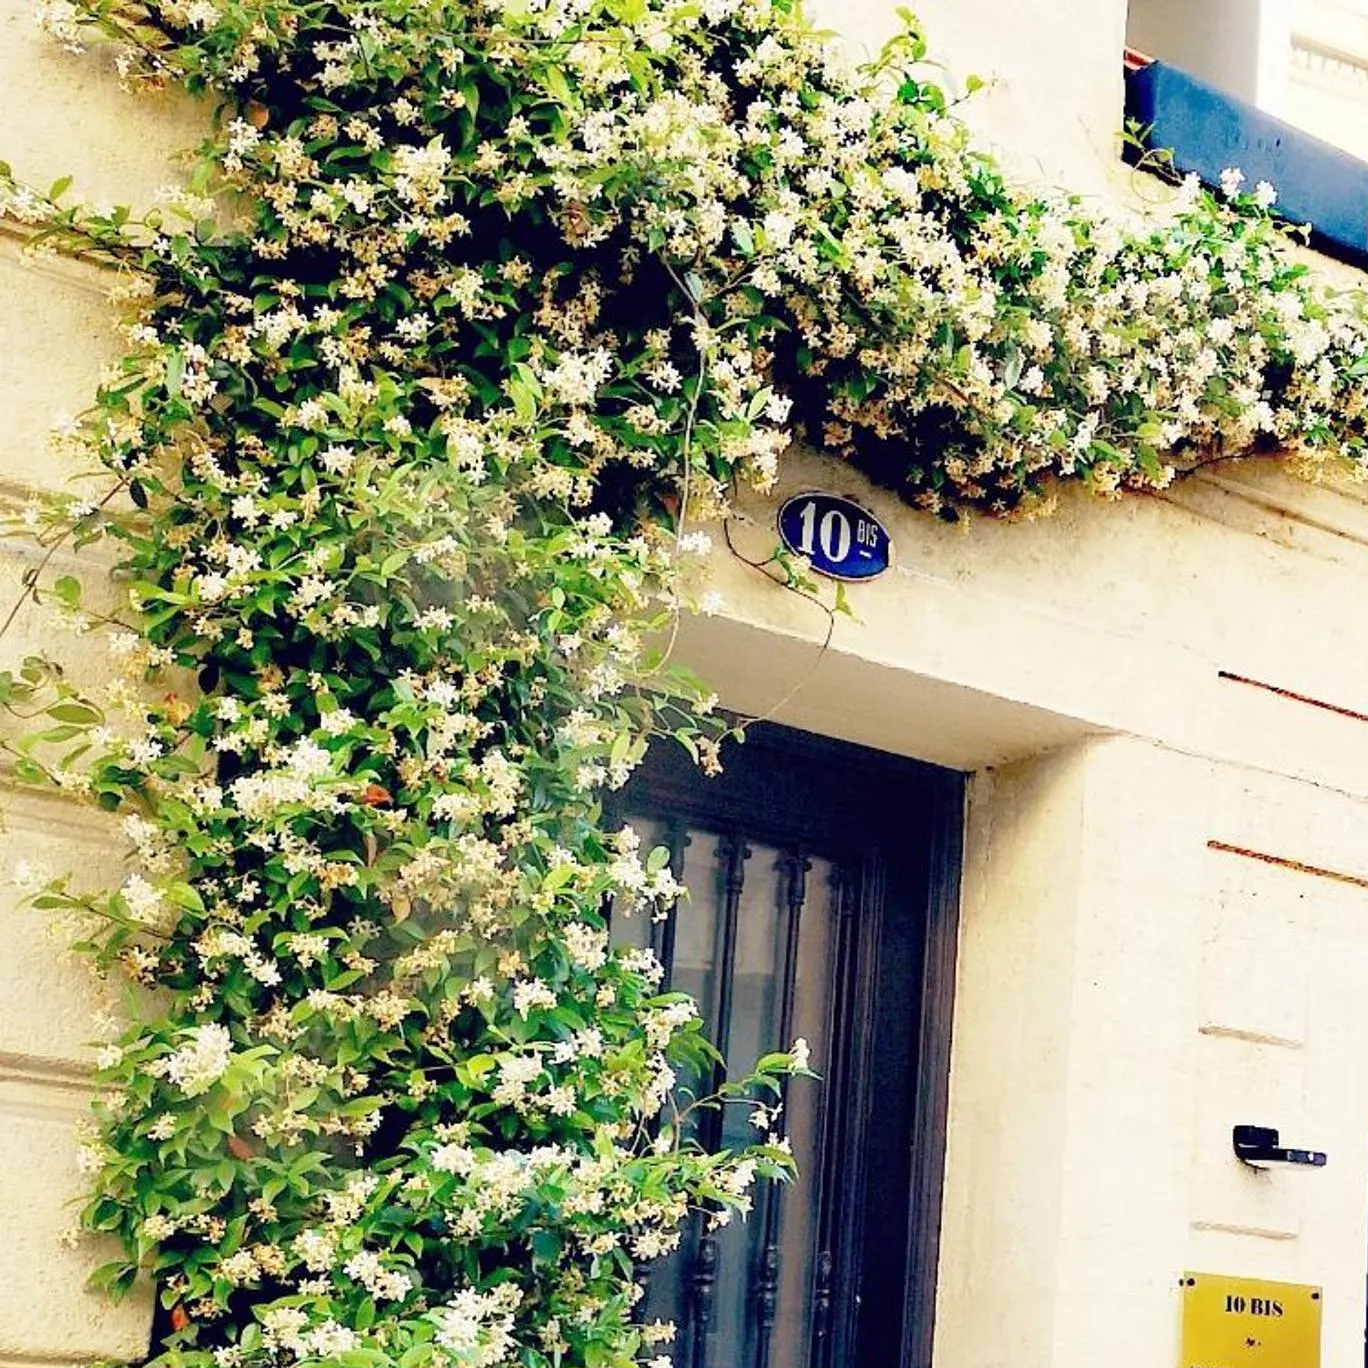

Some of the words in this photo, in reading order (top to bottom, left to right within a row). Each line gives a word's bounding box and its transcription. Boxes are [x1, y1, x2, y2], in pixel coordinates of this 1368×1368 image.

[798, 501, 851, 563] 10
[857, 519, 878, 548] BIS
[1226, 1295, 1246, 1312] 10
[1250, 1298, 1284, 1317] BIS
